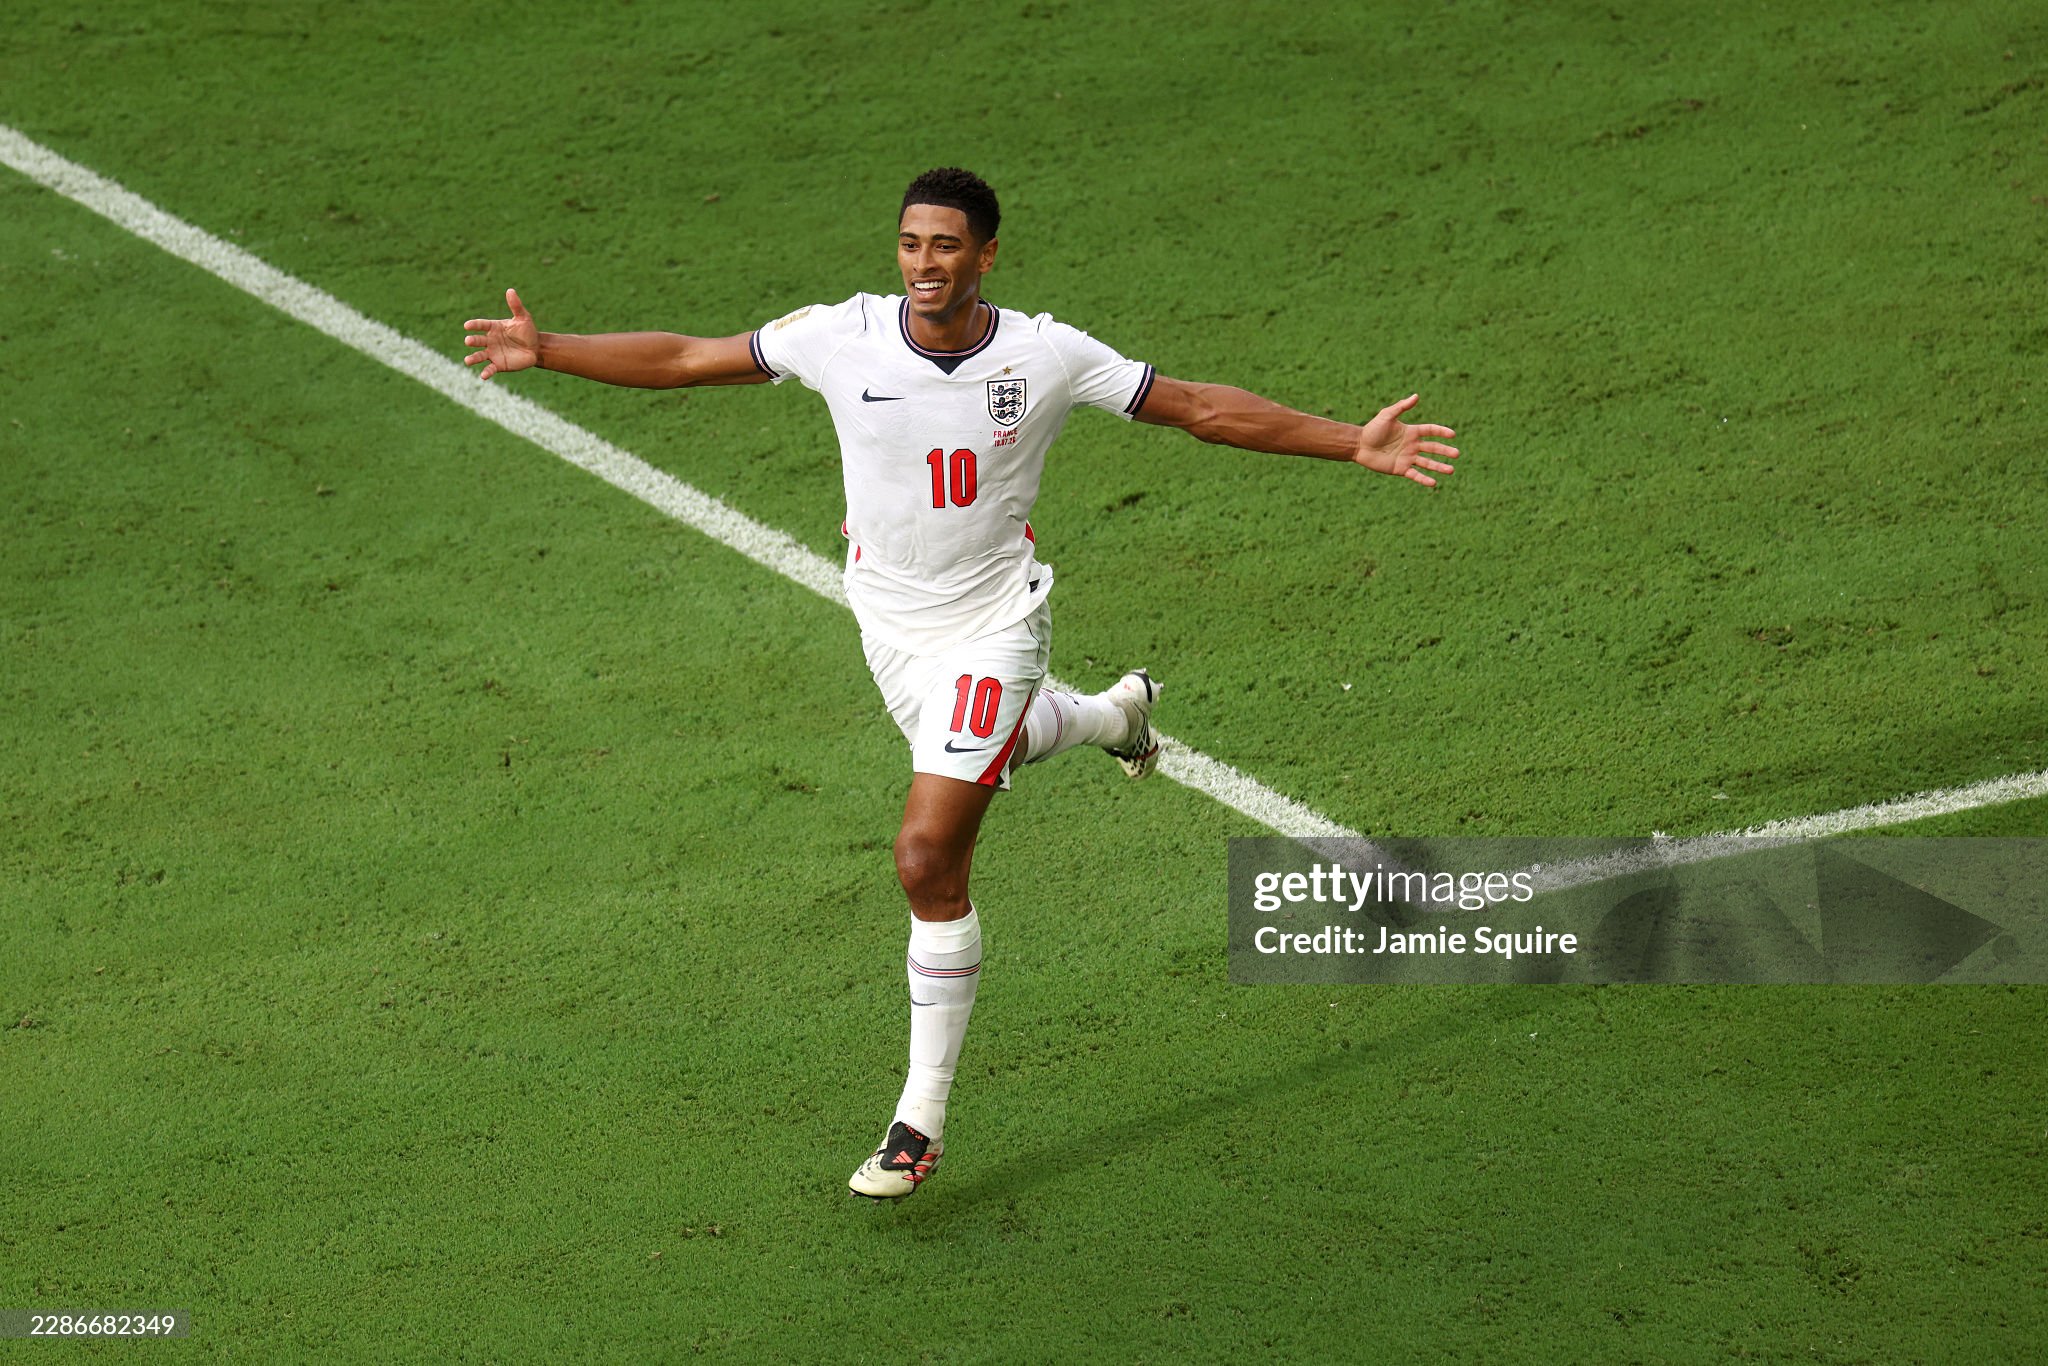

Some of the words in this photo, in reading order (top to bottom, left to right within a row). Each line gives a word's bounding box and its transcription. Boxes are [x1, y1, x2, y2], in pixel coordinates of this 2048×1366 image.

[993, 427, 1018, 438] FRANCE
[927, 448, 977, 508] 10
[950, 674, 1003, 739] 10
